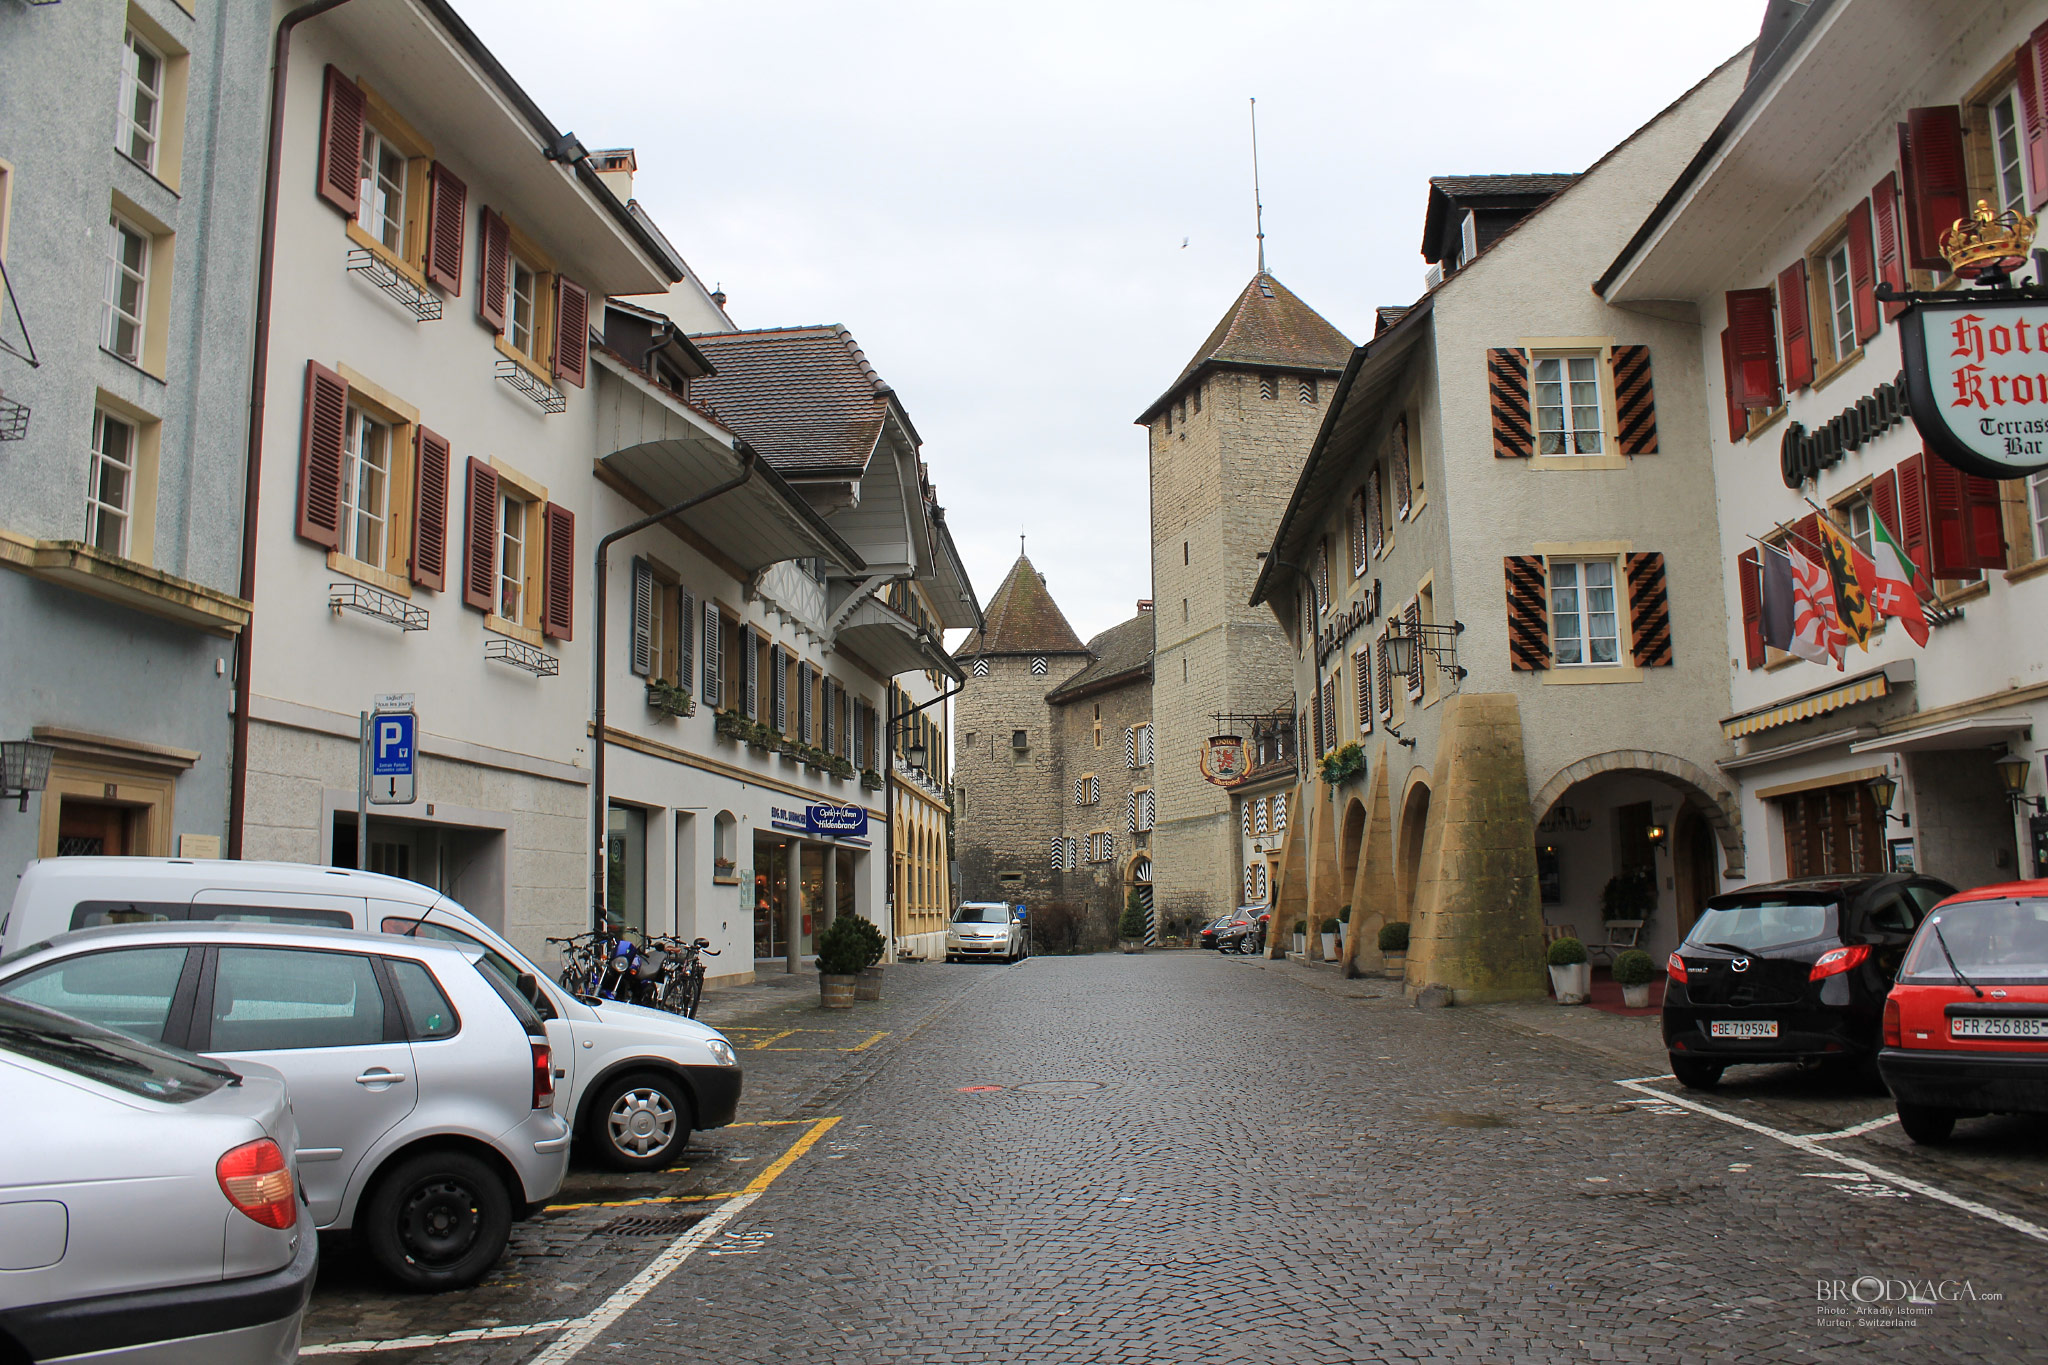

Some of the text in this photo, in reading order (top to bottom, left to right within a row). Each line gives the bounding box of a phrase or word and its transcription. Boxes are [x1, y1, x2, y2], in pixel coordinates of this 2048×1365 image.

[2004, 437, 2043, 459] Bar
[380, 722, 402, 759] P
[819, 808, 834, 819] Optik
[842, 808, 857, 818] Uhren
[818, 819, 856, 829] Hildenbrand
